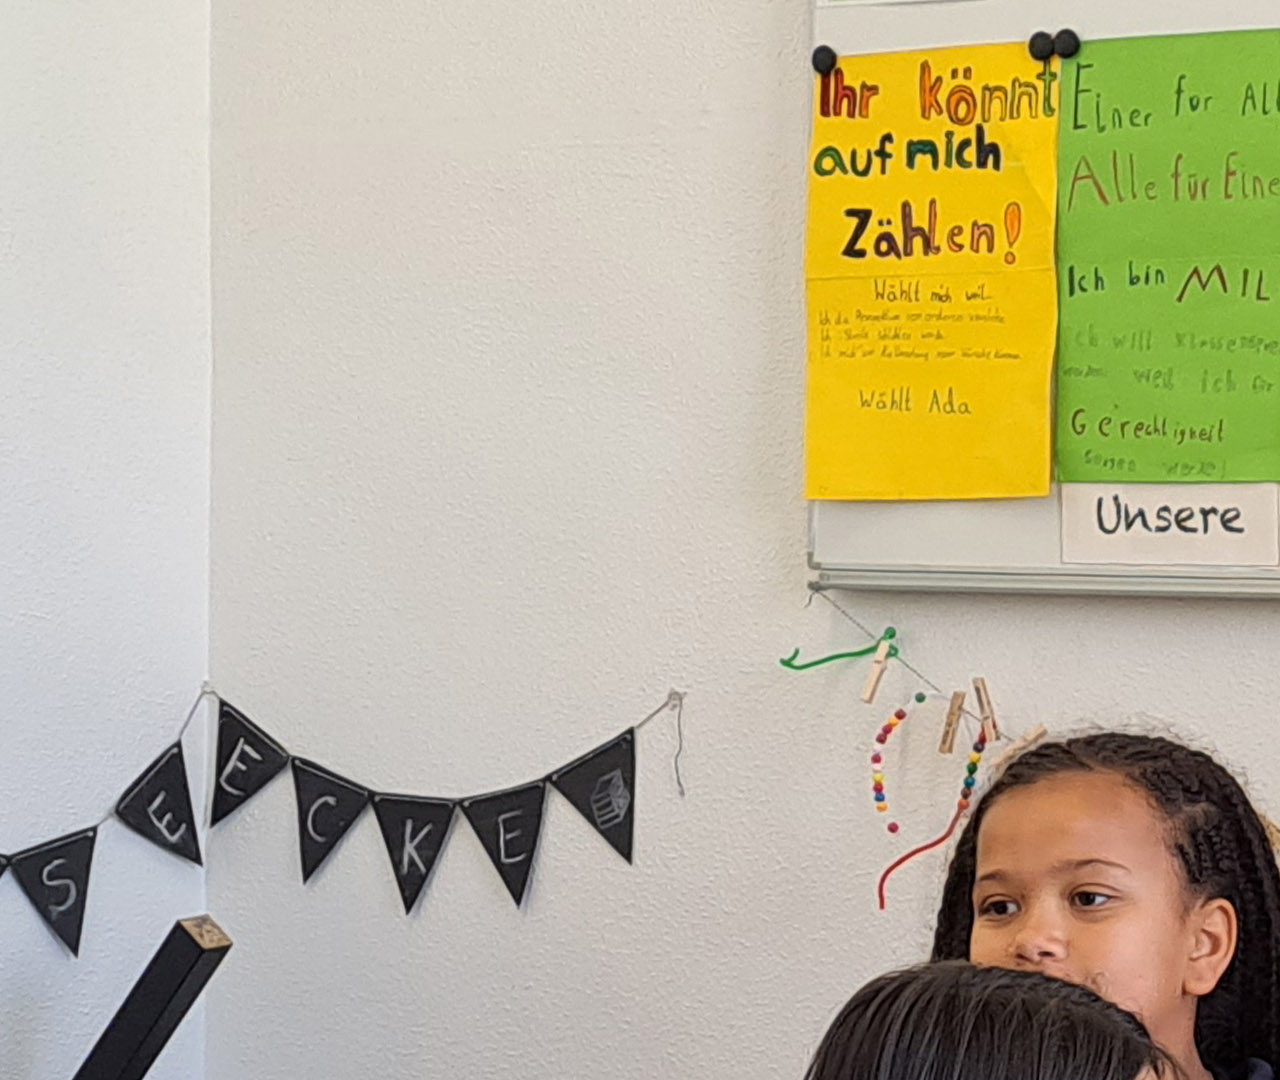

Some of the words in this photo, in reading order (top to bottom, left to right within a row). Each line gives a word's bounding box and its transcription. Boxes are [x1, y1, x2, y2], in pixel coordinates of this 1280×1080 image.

[819, 66, 879, 119] Ihr
[919, 60, 1058, 125] könnt
[1073, 62, 1152, 133] Einer
[813, 133, 894, 177] auf
[906, 125, 1000, 171] mich
[1067, 150, 1157, 213] Alle
[1171, 153, 1210, 202] für
[841, 199, 1023, 265] Zählen!
[874, 279, 920, 302] Wählt
[931, 284, 952, 303] mich
[1068, 264, 1105, 297] Ich
[1128, 260, 1165, 286] bin
[859, 386, 911, 412] Wählt
[930, 387, 972, 414] Ada
[1097, 494, 1246, 535] Unsere
